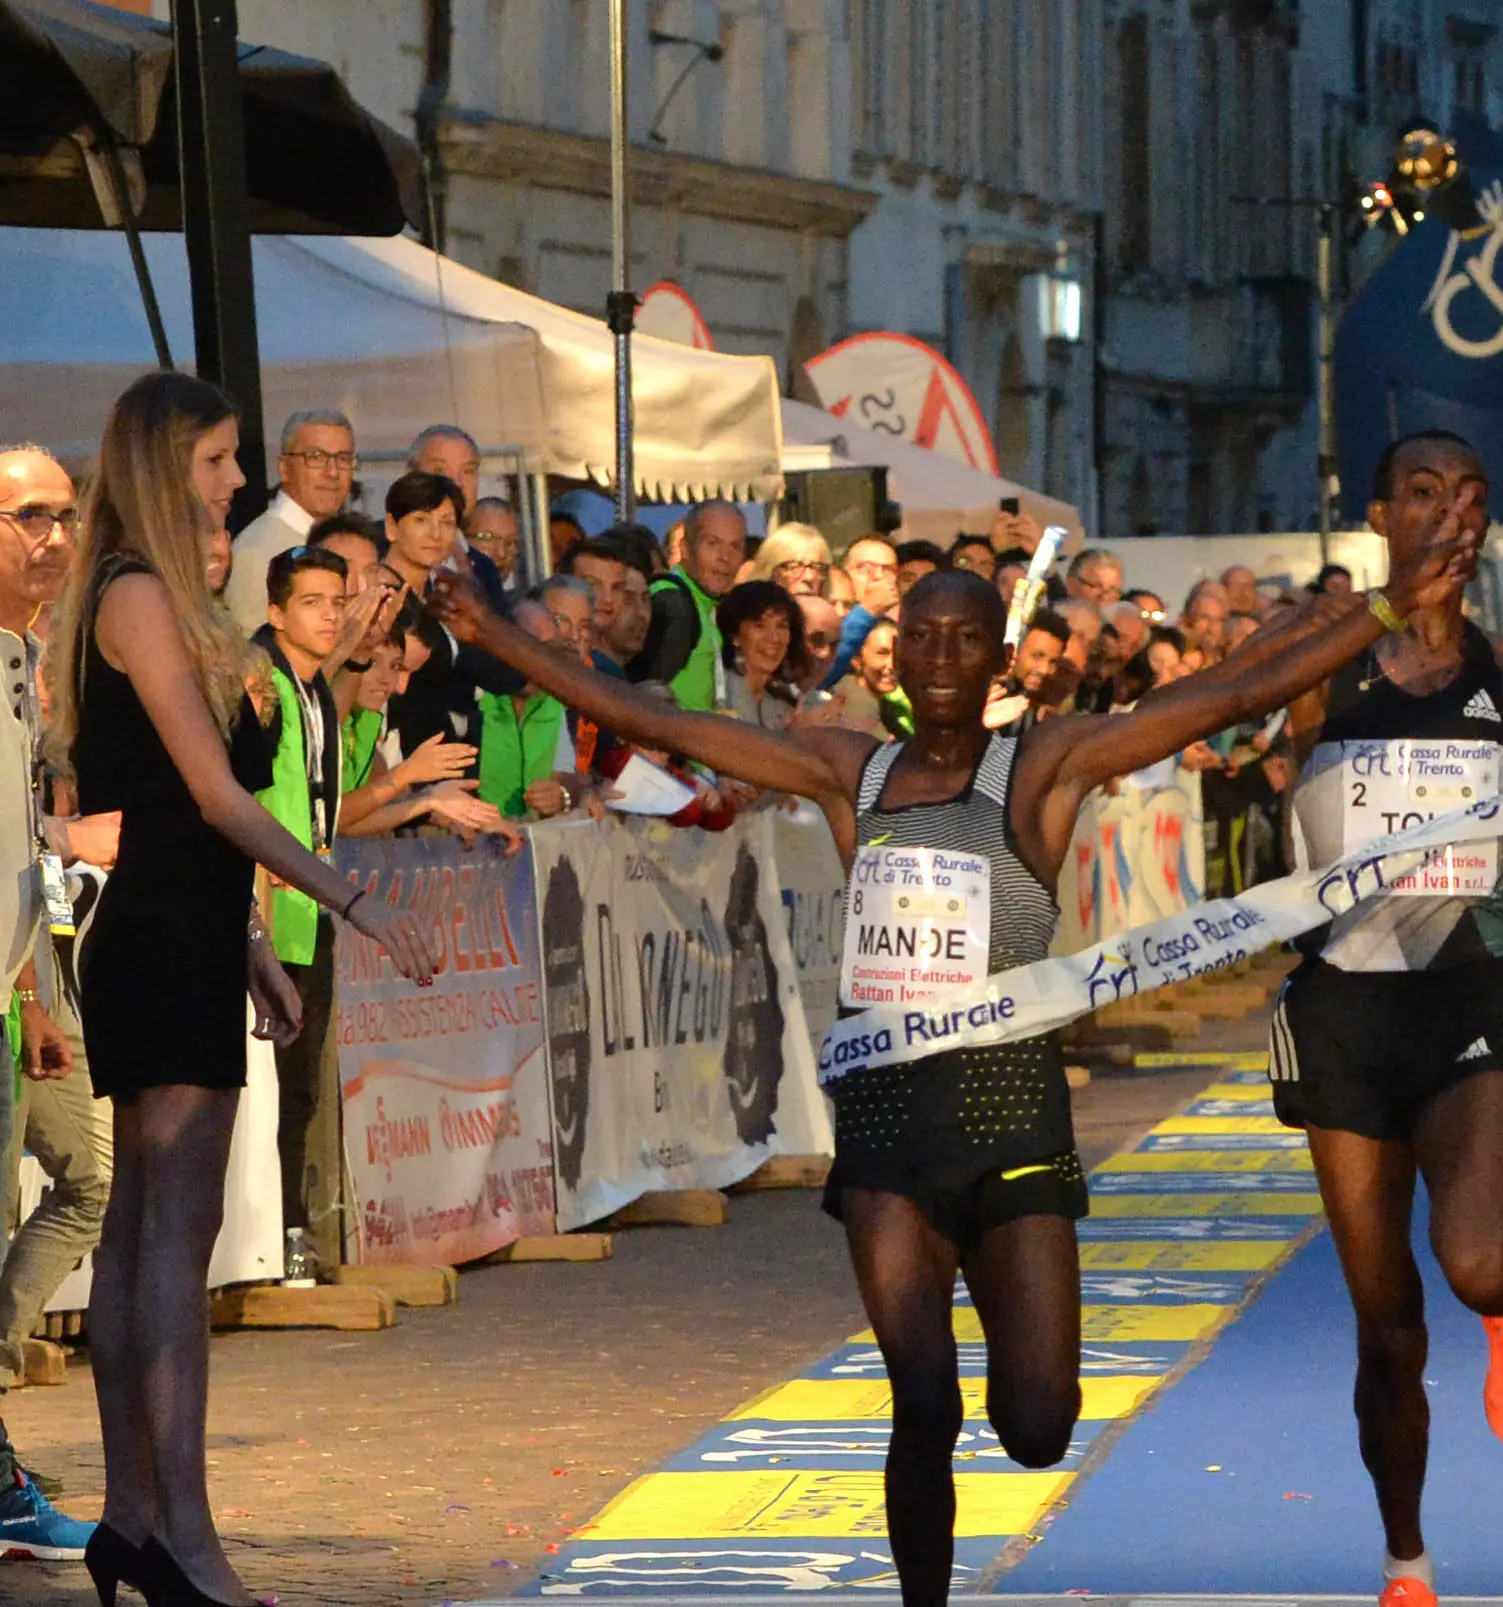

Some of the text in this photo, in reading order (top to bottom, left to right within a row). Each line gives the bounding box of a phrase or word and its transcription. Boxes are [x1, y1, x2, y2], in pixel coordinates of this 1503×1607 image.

[1446, 744, 1494, 760] Rurale
[1417, 760, 1465, 776] Trento
[1351, 782, 1367, 807] 2
[884, 852, 982, 874] Cass Rurale
[883, 868, 952, 887] di Treto
[853, 889, 864, 916] 8
[1142, 936, 1201, 968] Cassa
[817, 995, 1016, 1071] Cassa Rurale
